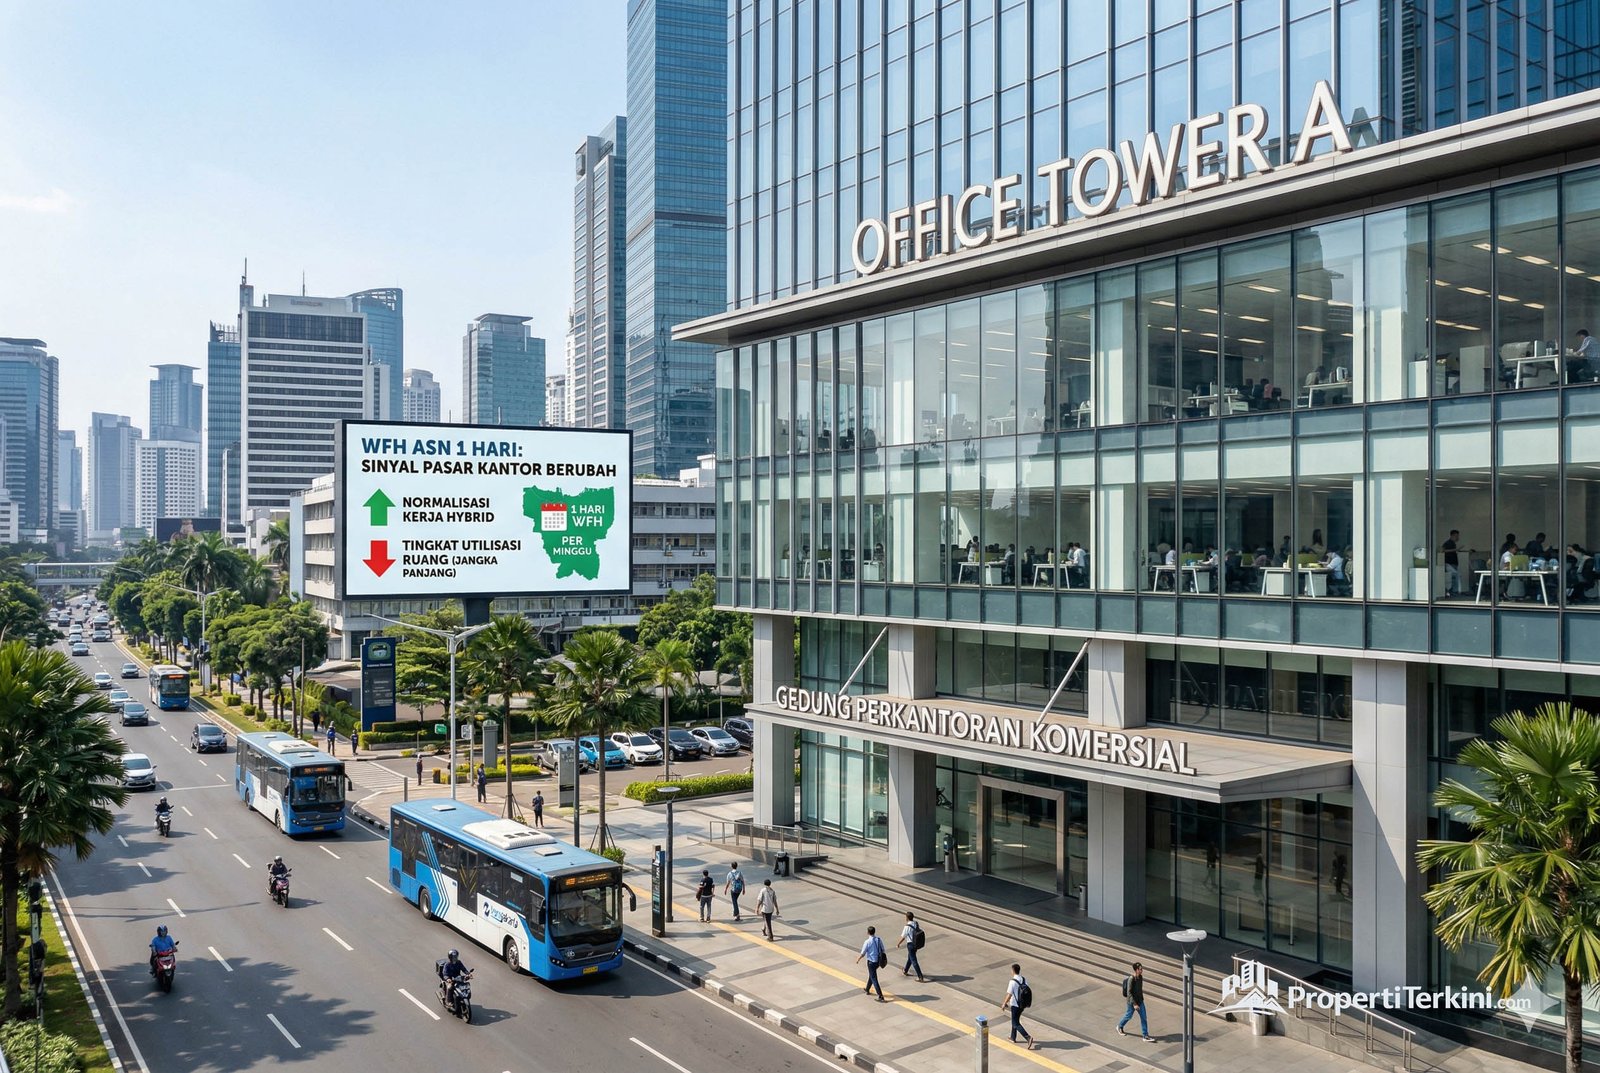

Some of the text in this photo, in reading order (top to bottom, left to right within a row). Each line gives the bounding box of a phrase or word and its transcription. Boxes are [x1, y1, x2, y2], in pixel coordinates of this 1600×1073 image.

[852, 80, 1352, 275] OFFICE TOWER A
[362, 438, 522, 457] WFH ASN 1 HARI:
[362, 460, 616, 477] SINYAL PASAR KANTOR BERUBAH
[403, 497, 489, 508] NORMALISASI
[571, 504, 604, 514] 1 HARI
[403, 512, 494, 522] KERJA HYBRID
[573, 516, 602, 526] WFH
[402, 540, 520, 550] TINGKAT UTILISASI
[562, 536, 582, 545] PER
[403, 555, 498, 565] RUANG (JANGKA
[403, 569, 456, 577] PANJANG)
[776, 685, 1196, 775] GEDUNG PERKANTORAN KOMERSIAL
